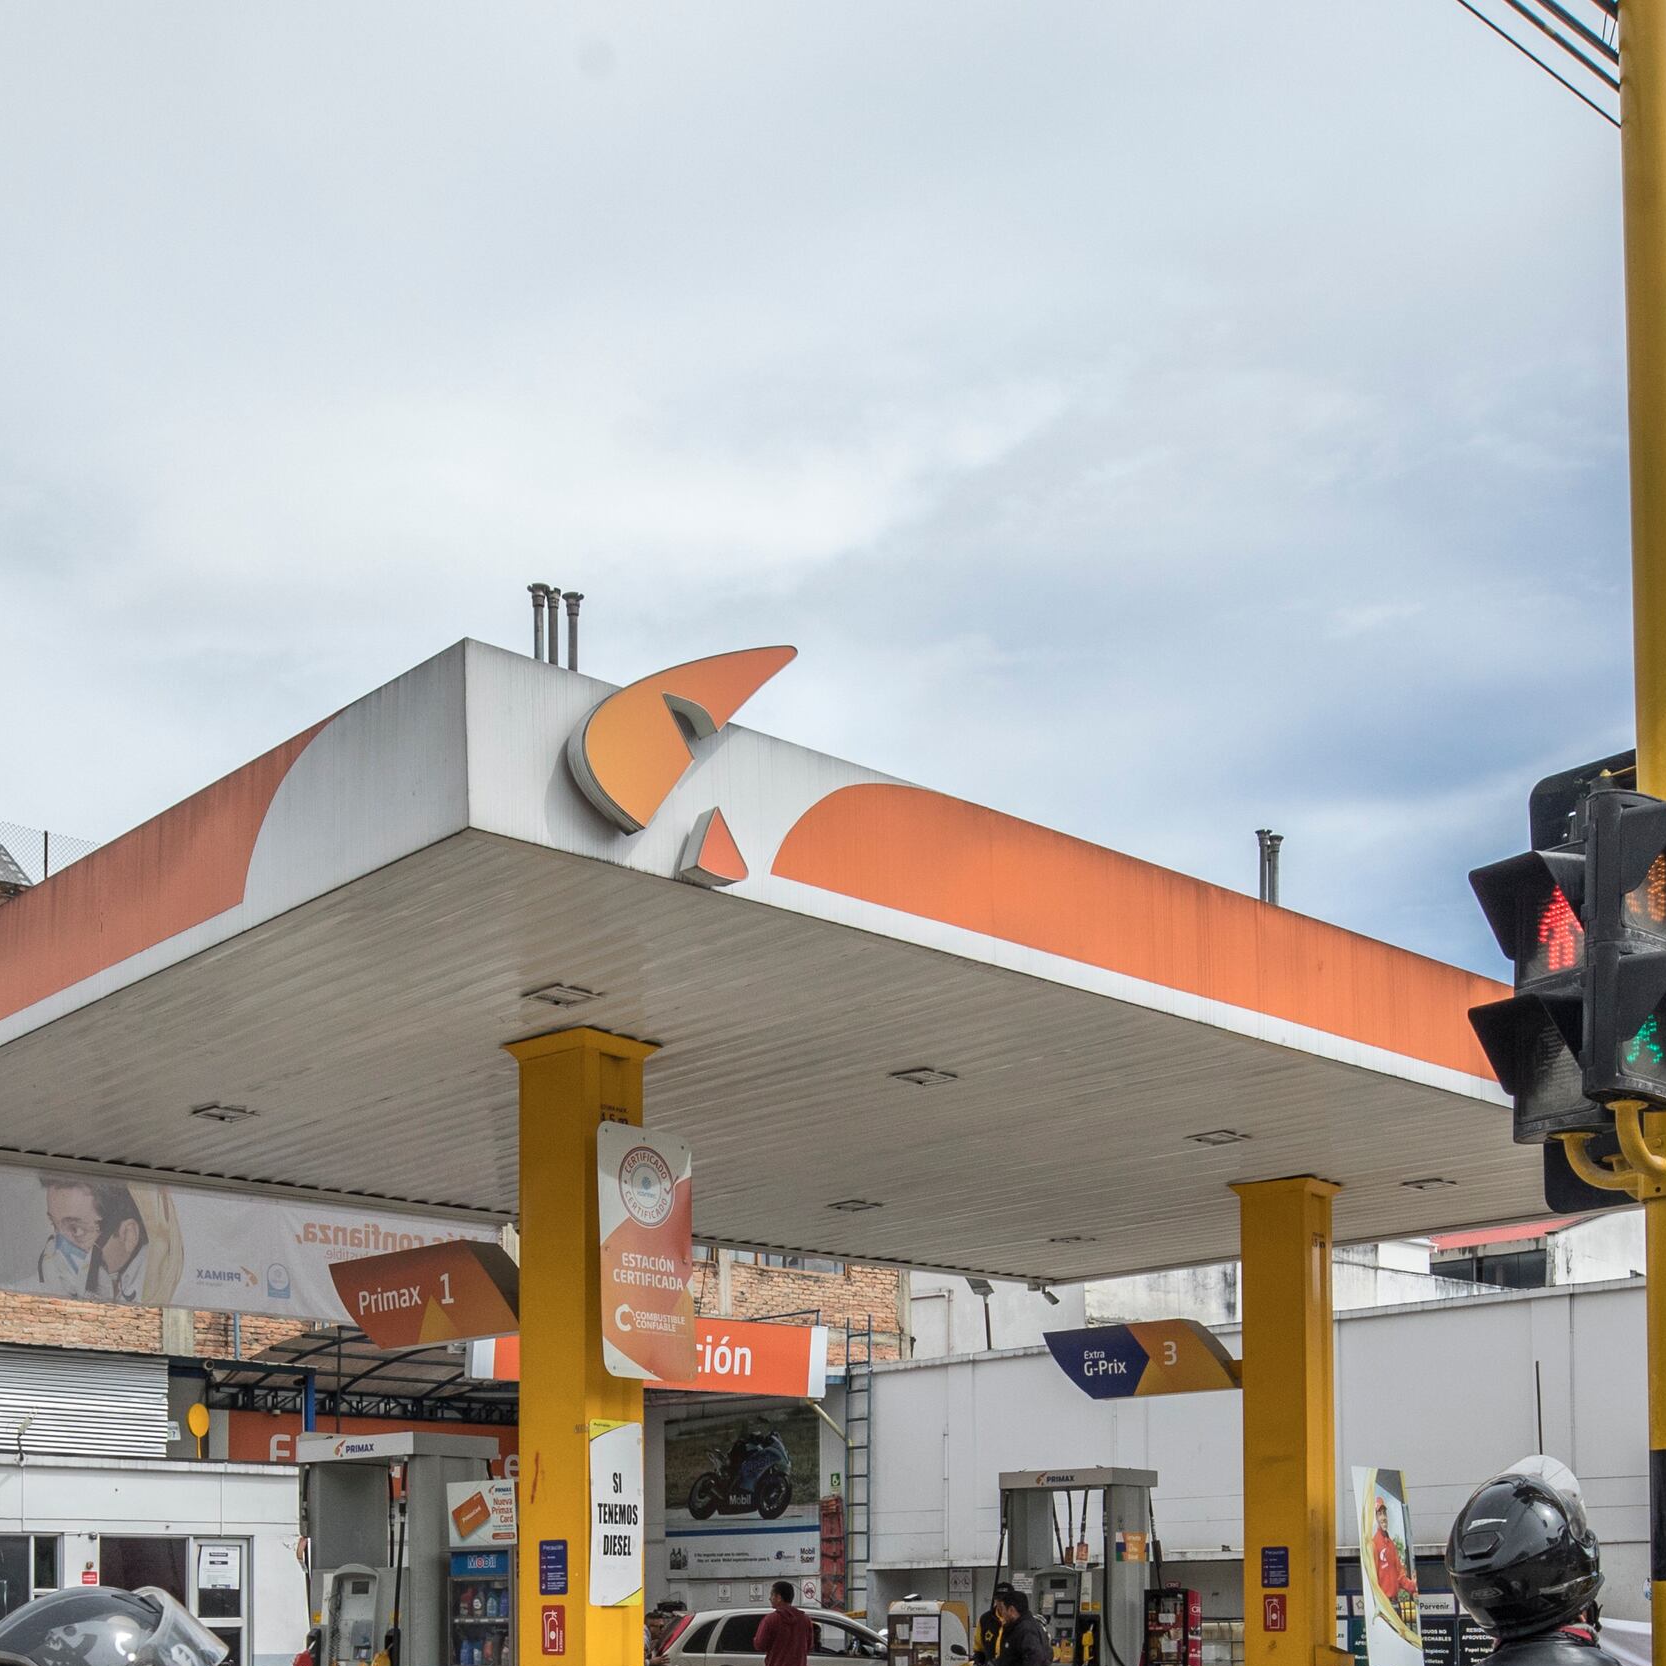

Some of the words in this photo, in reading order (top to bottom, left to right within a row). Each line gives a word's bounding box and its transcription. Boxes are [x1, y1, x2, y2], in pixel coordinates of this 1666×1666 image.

[625, 1152, 667, 1179] CERTIFICADO
[626, 1191, 667, 1219] CERTIFICADO
[622, 1253, 674, 1273] ESTACIÓN
[613, 1269, 683, 1291] CERTIFICADA
[358, 1285, 422, 1315] Primax
[439, 1272, 454, 1305] 1
[635, 1311, 685, 1325] COMBUSTIBLE
[636, 1320, 677, 1332] CONFIABLE
[1084, 1351, 1105, 1359] Extra
[1163, 1341, 1177, 1365] 3
[1084, 1360, 1127, 1376] G-Prix
[346, 1443, 374, 1454] PRIMAX
[613, 1473, 622, 1493] SI
[1047, 1475, 1075, 1483] PRIMAX
[729, 1495, 752, 1505] Mobil
[500, 1515, 514, 1523] Card
[597, 1503, 638, 1525] TENEMOS
[603, 1535, 631, 1556] DIESEL
[800, 1547, 815, 1555] Mobil
[467, 1554, 496, 1568] Mobil
[800, 1555, 815, 1563] Super
